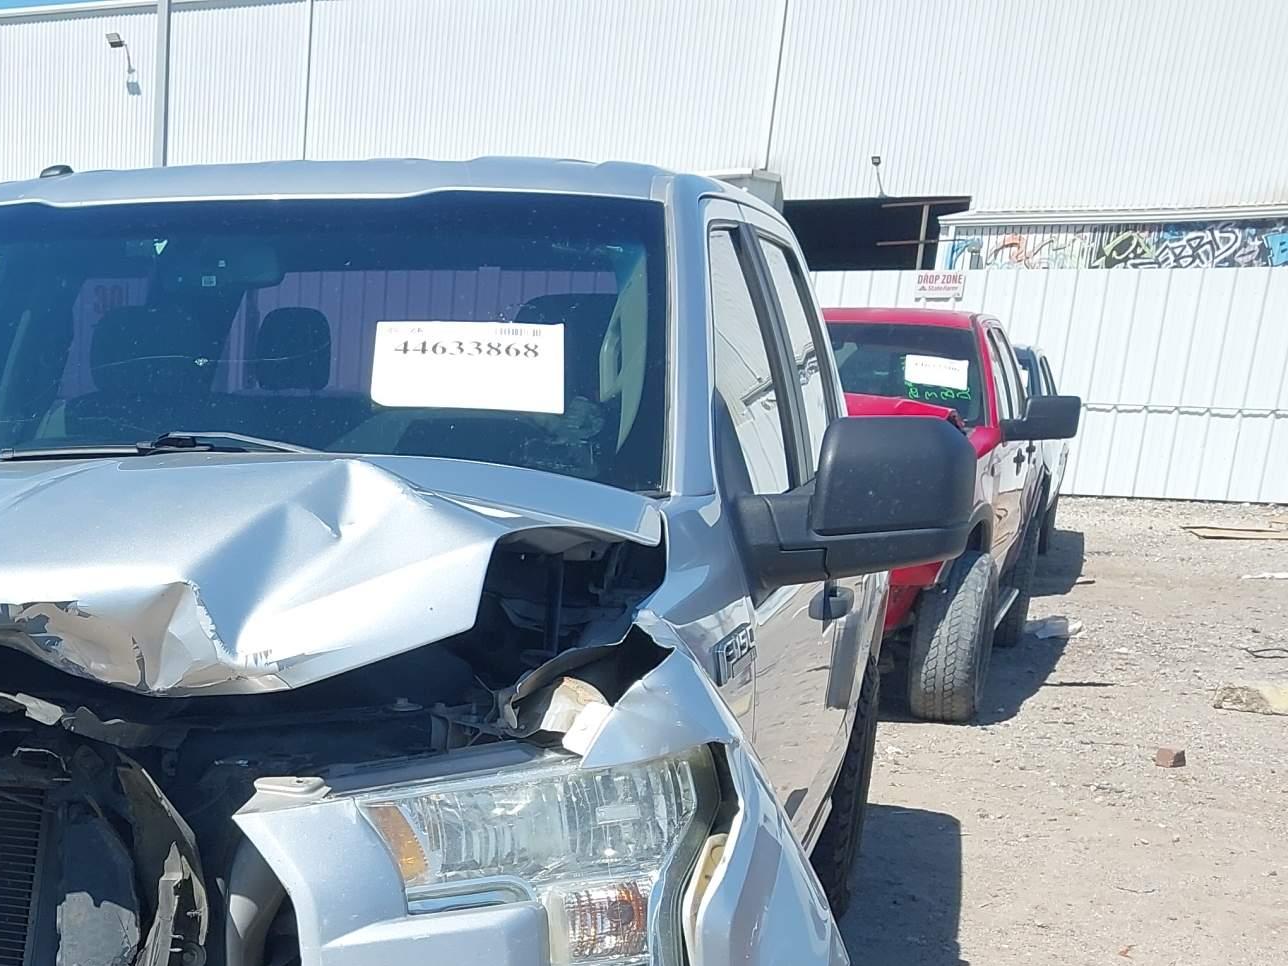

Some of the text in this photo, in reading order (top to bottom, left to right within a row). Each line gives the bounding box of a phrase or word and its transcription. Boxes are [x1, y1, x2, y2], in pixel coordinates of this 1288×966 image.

[917, 274, 963, 284] DROP ZONE
[394, 340, 540, 358] 44633868
